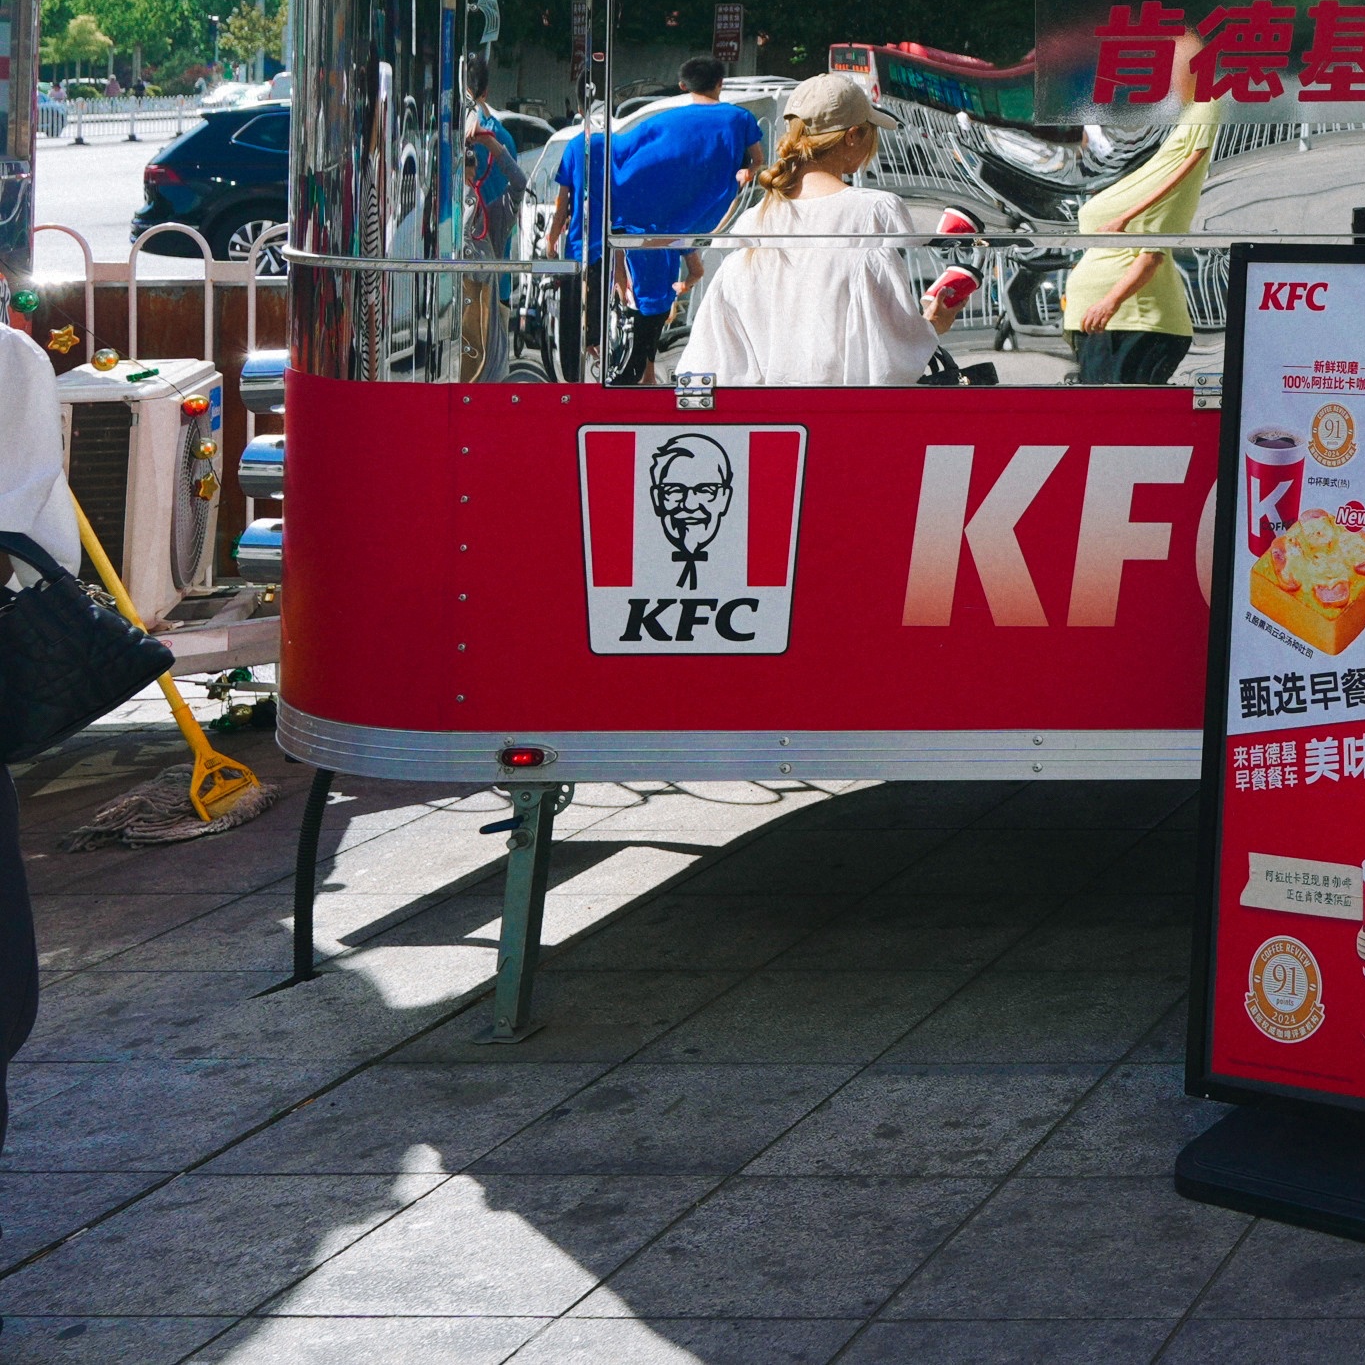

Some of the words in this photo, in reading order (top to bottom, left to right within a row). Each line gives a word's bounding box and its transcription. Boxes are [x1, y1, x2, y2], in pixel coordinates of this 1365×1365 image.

[1259, 282, 1329, 311] KFC
[1313, 360, 1360, 375] 新鲜现磨
[1324, 419, 1342, 439] 91
[1323, 449, 1341, 457] 2024
[1307, 476, 1350, 489] 中杯美式(热)
[902, 445, 1221, 627] KF
[619, 598, 758, 642] KFC
[1233, 741, 1297, 769] 来肯德基
[1234, 765, 1299, 792] 早餐餐车
[1261, 942, 1284, 962] COFFEE
[1285, 942, 1312, 969] REVIEW
[1272, 964, 1299, 996] 91
[1276, 998, 1295, 1007] points
[1271, 1011, 1297, 1025] 2024
